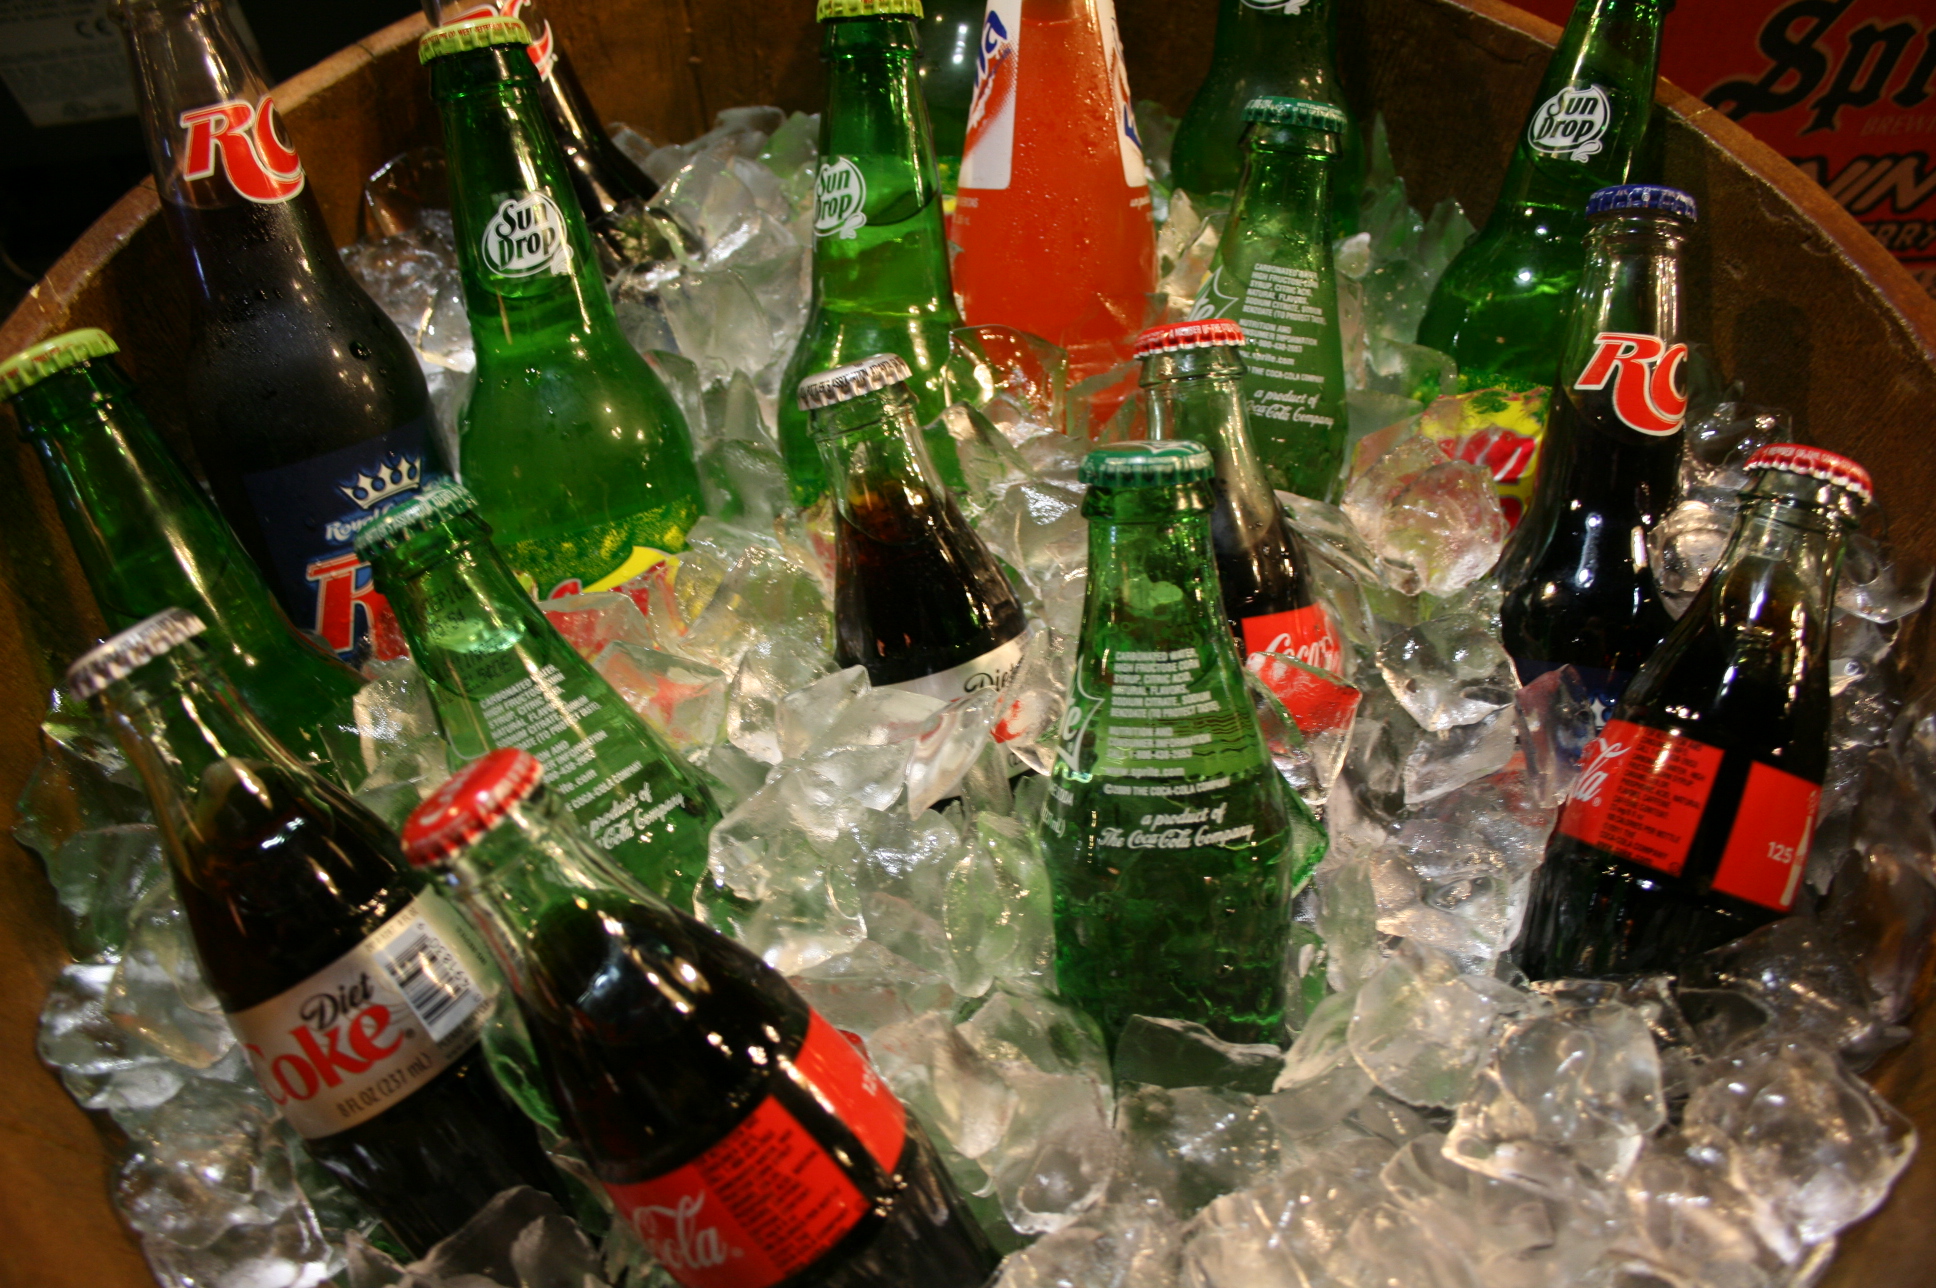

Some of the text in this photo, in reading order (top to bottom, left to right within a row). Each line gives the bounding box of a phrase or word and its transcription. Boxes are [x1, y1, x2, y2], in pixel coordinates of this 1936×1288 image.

[1547, 92, 1600, 118] Sun
[1535, 115, 1595, 143] Drop
[179, 95, 305, 205] RC
[816, 167, 851, 197] Sun
[495, 202, 549, 237] Sun
[497, 226, 556, 269] Drop
[1261, 389, 1307, 404] product
[1573, 331, 1688, 437] RC
[549, 740, 569, 755] AND
[571, 760, 642, 808] COCA-COLA COMPANY
[589, 783, 651, 837] product of
[635, 792, 684, 829] Company
[1140, 802, 1229, 832] a product of
[1098, 827, 1125, 848] The
[1194, 824, 1255, 848] Company
[1767, 841, 1794, 864] 125
[300, 971, 374, 1031] Diet
